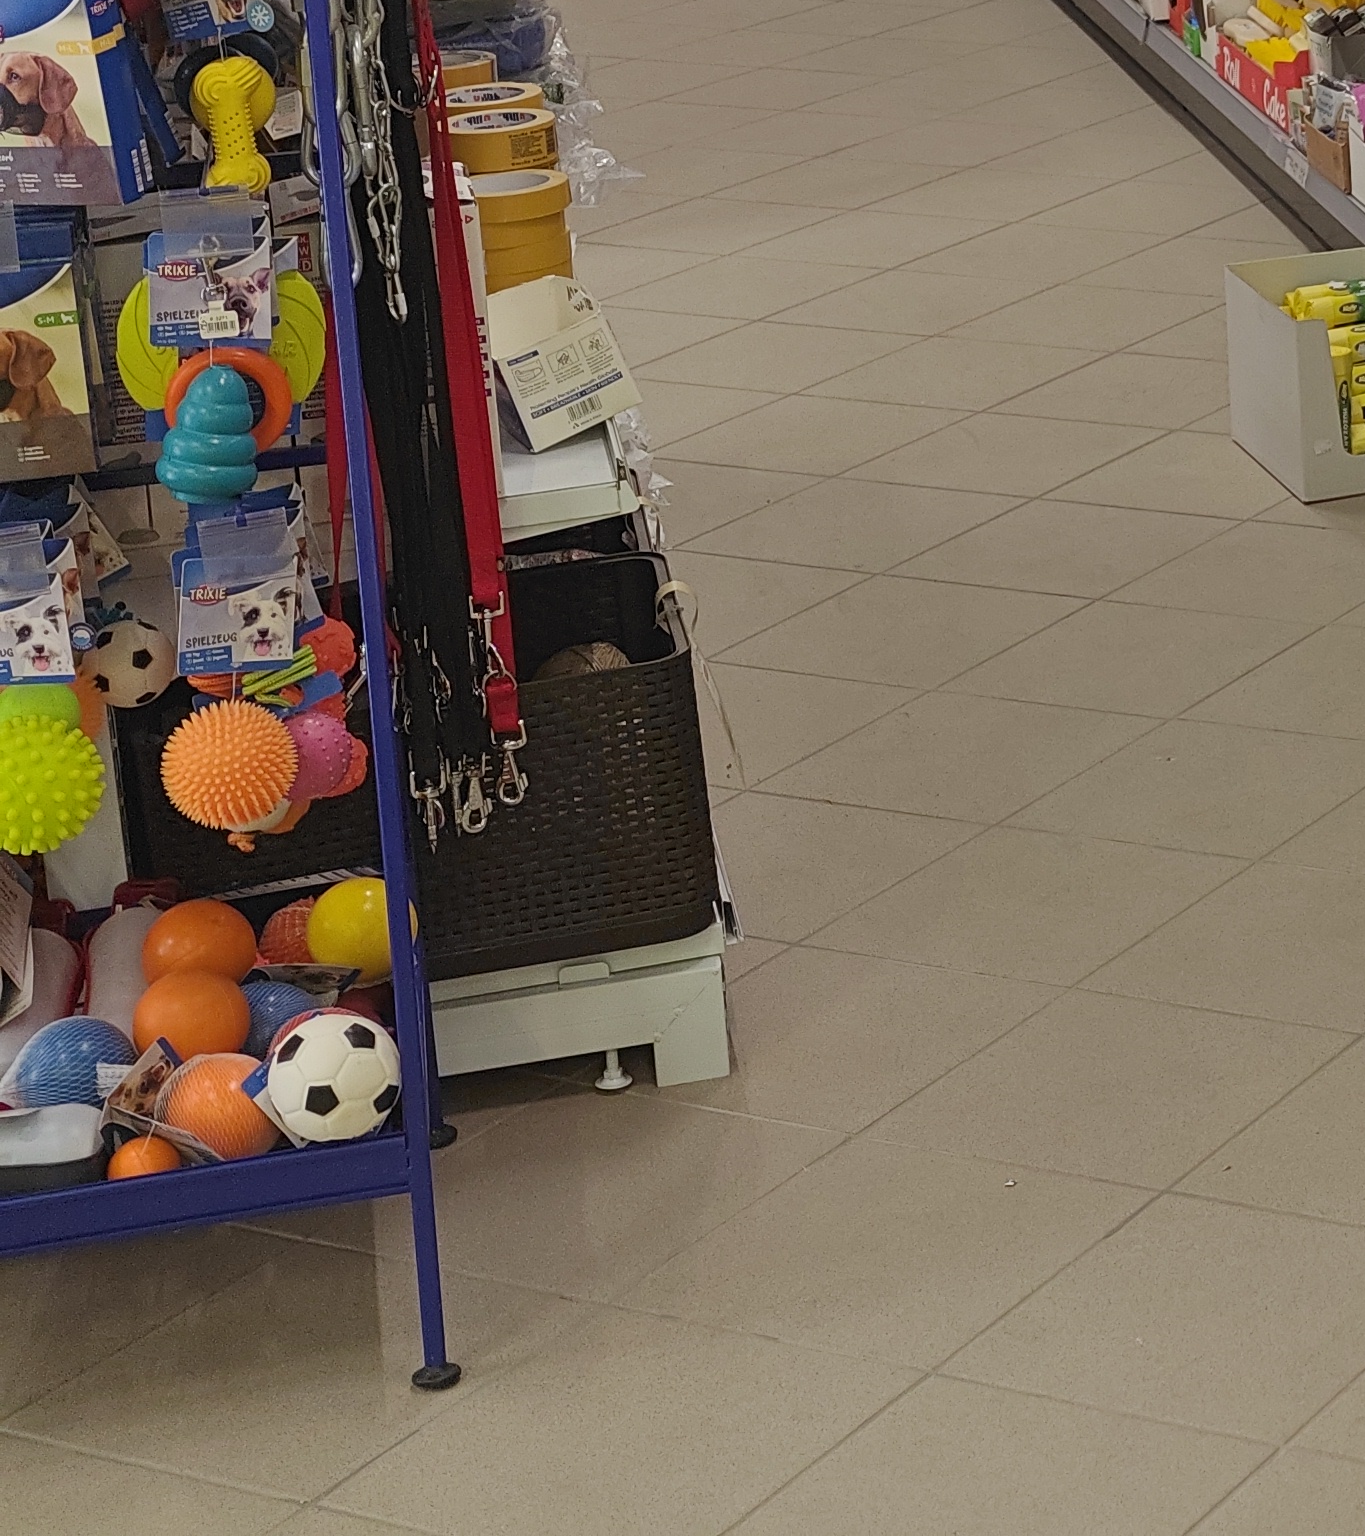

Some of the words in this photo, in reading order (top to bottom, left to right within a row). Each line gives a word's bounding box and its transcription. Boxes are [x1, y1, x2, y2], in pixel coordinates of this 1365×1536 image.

[157, 263, 197, 277] TRIXIE
[37, 316, 55, 325] S-M
[189, 588, 227, 601] TRIXIE
[185, 632, 238, 649] SPIELZEUG
